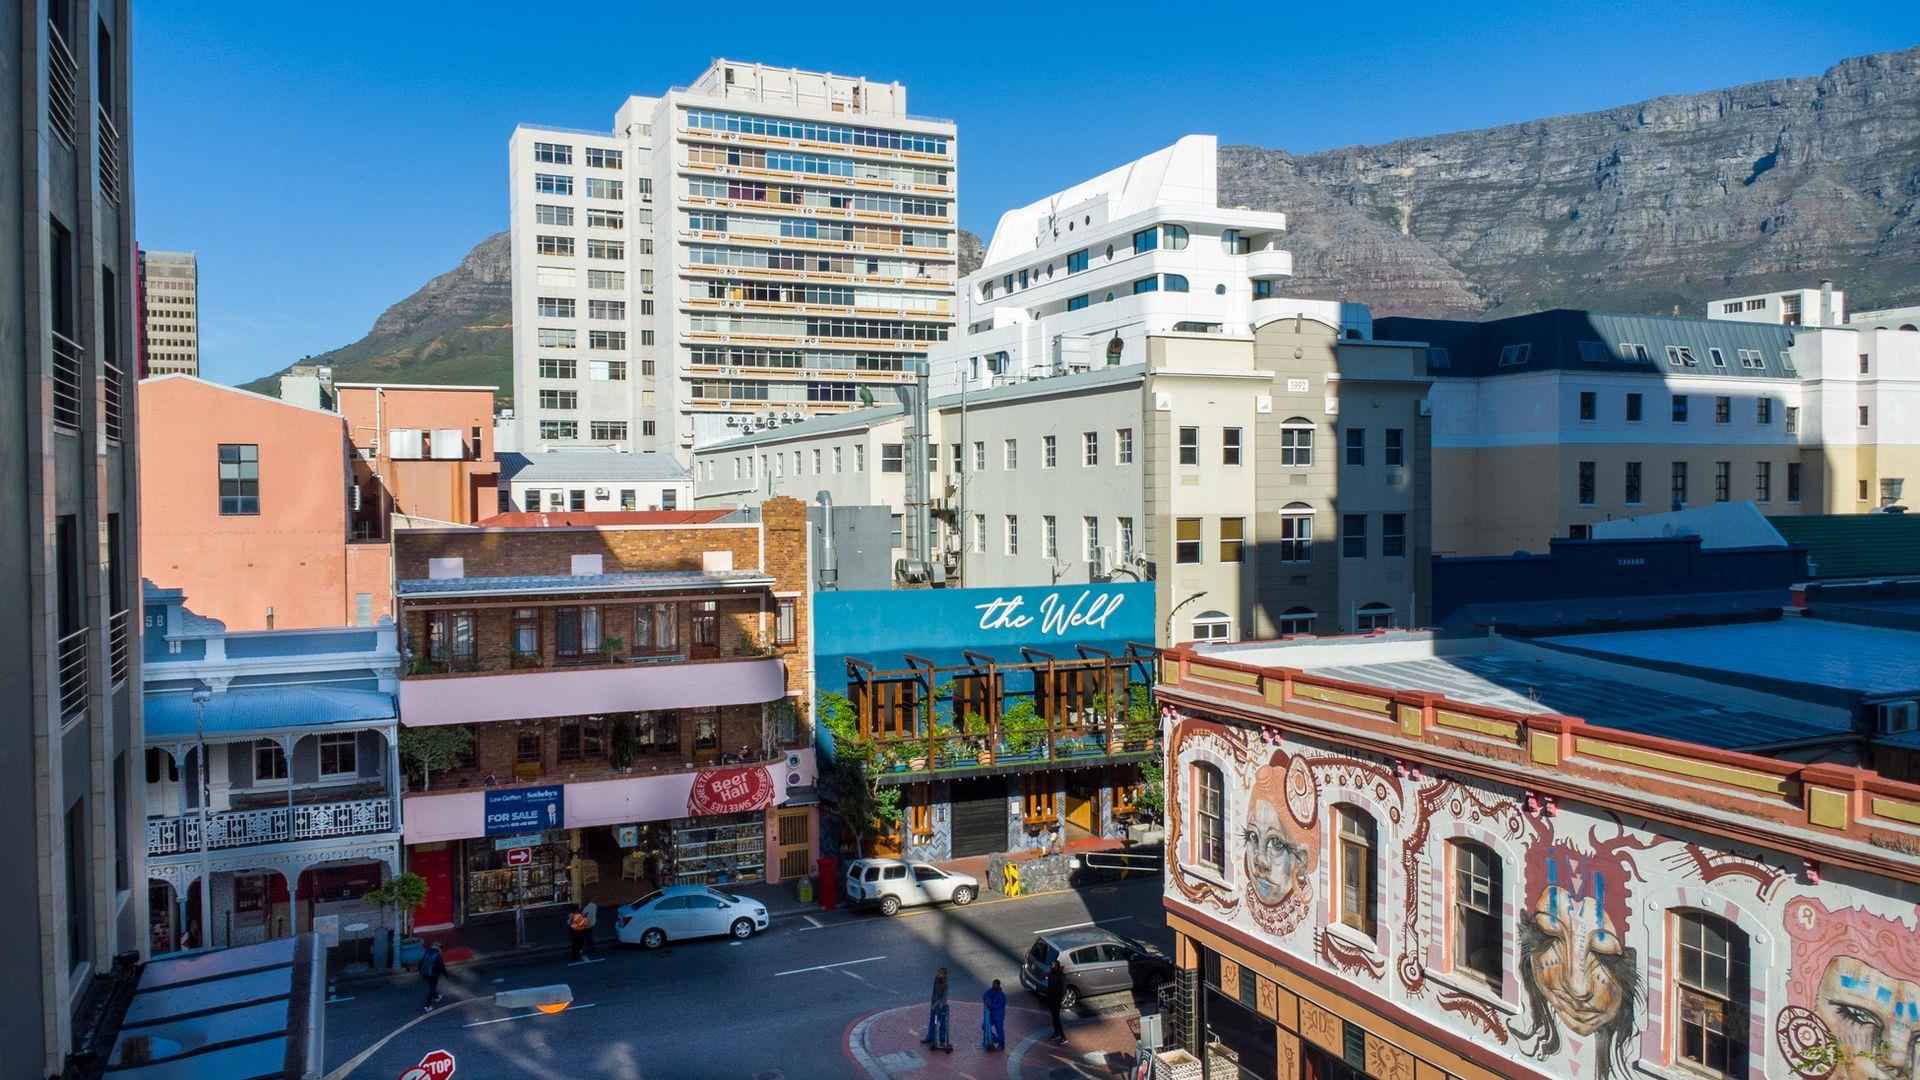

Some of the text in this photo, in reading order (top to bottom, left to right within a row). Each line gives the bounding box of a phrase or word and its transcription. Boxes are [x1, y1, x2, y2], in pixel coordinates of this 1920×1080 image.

[1290, 380, 1306, 390] 1992
[975, 590, 1125, 636] the Well
[711, 772, 748, 793] Beer
[720, 782, 750, 802] Hall
[488, 810, 539, 823] FOR SALE
